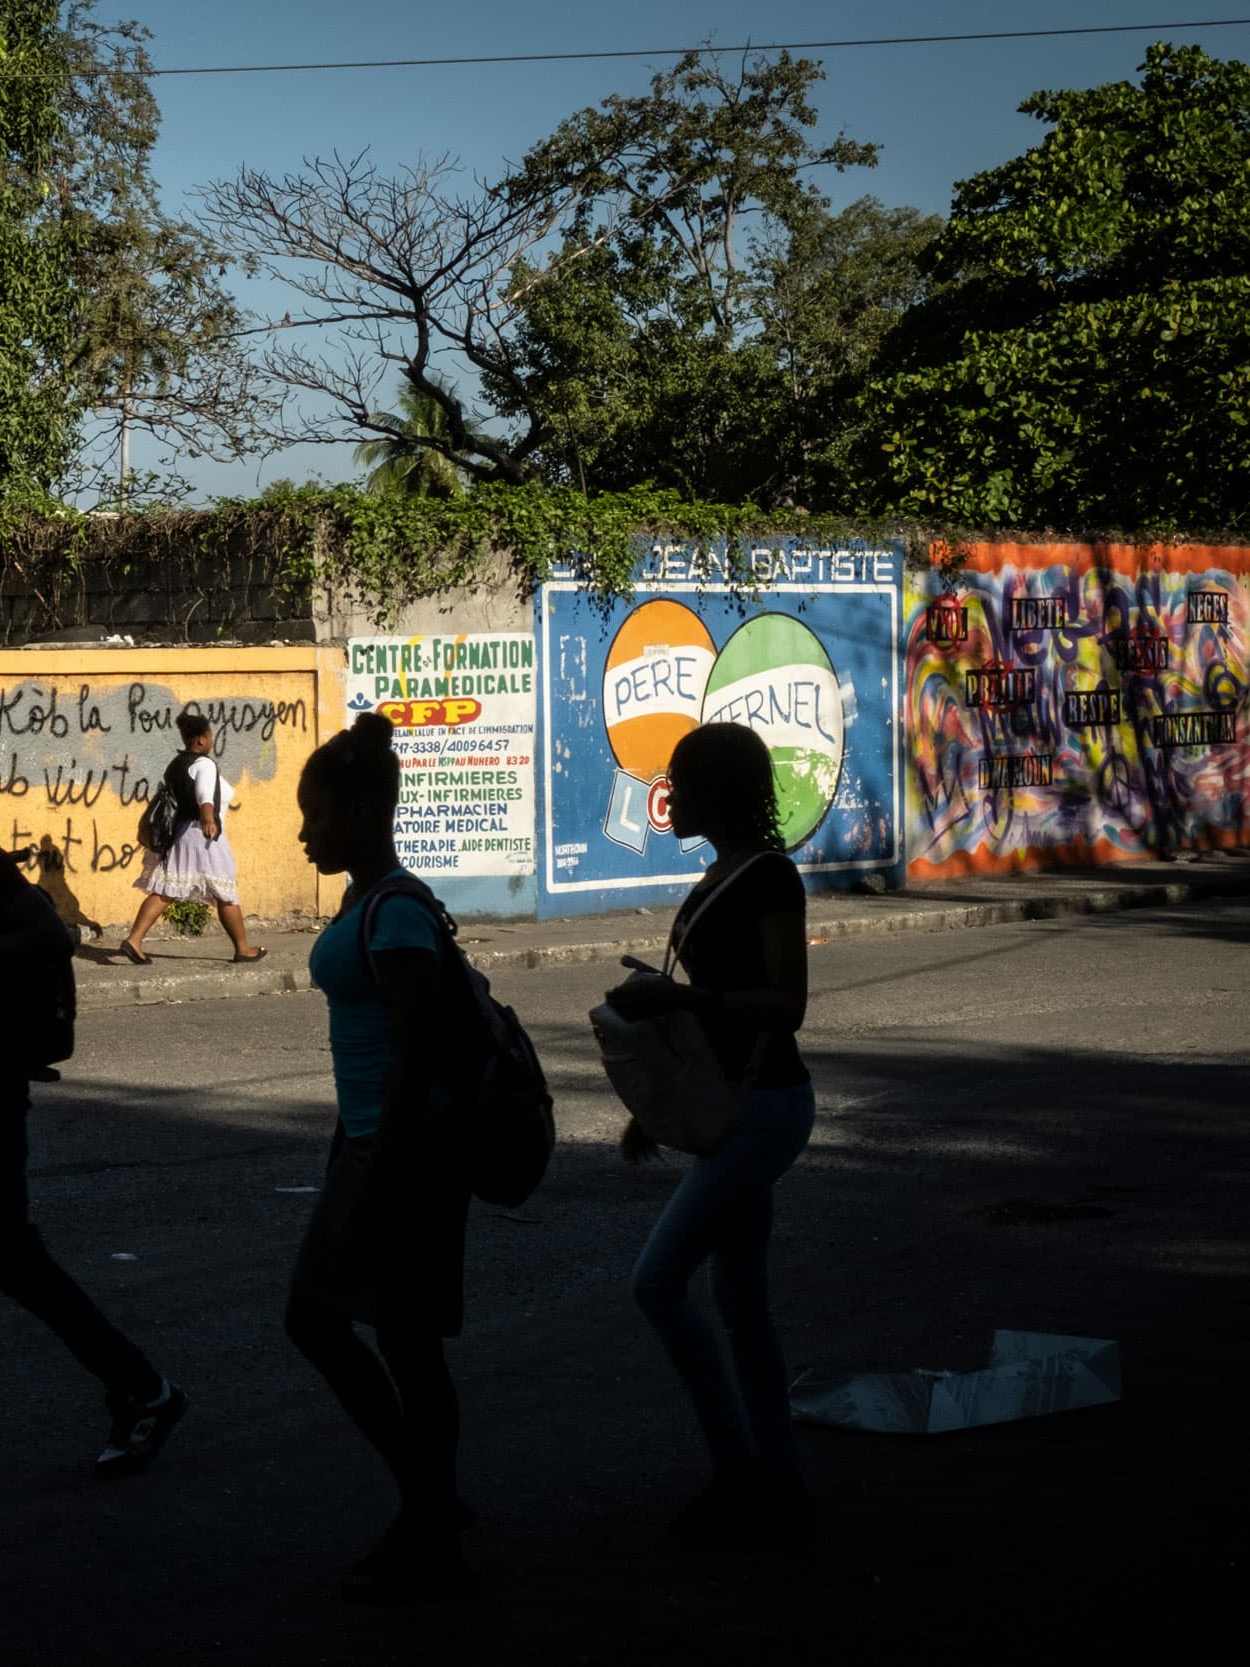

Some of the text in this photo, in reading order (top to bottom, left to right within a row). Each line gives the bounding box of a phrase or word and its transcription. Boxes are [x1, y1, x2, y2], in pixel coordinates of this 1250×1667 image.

[642, 545, 729, 580] JEAN
[751, 547, 894, 582] BAPTISTE
[1011, 598, 1063, 630] LIBETE
[352, 643, 423, 675] CENTRE
[433, 638, 533, 671] FORMATION
[375, 673, 532, 699] PARAMEDICALE
[614, 656, 697, 717] PERE
[381, 699, 477, 725] CFP
[708, 681, 835, 744] TERNEL
[448, 726, 465, 736] FACE
[468, 725, 477, 735] DE
[412, 757, 427, 767] PAR
[428, 757, 437, 767] LE
[455, 756, 467, 767] AU
[467, 755, 500, 767] NUMERO
[399, 771, 518, 787] INFIRMIERES
[397, 802, 508, 818] PHARMACIEN
[393, 818, 509, 834] ATOIRE MEDICAL
[396, 839, 456, 854] THERAPIE
[485, 837, 531, 852] DENTISTE
